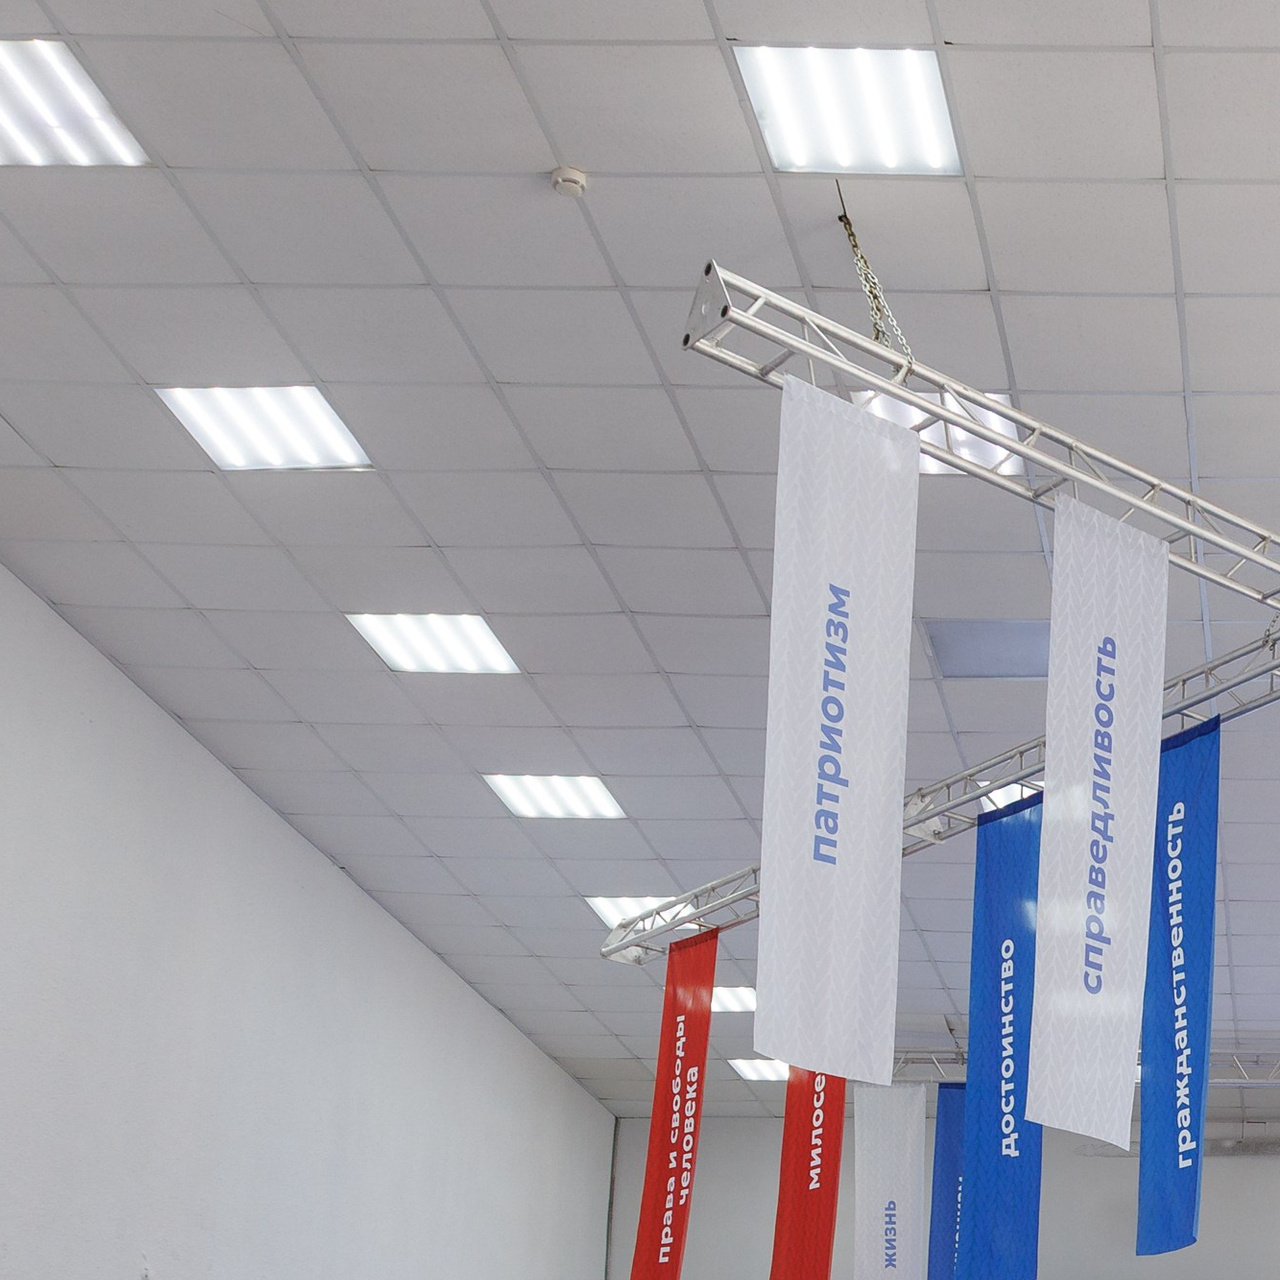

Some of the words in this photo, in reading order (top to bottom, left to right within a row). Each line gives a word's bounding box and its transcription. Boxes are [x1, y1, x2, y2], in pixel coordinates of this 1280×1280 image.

[813, 583, 850, 866] патриотизм
[1083, 635, 1117, 995] справедливость
[1001, 938, 1020, 1158] достоинство
[1167, 800, 1193, 1169] гражданственность
[670, 1015, 687, 1143] свободы
[679, 1066, 699, 1205] человека
[808, 1071, 826, 1190] милосе
[658, 1176, 676, 1263] права
[669, 1151, 677, 1169] и
[884, 1200, 897, 1269] жизнь
